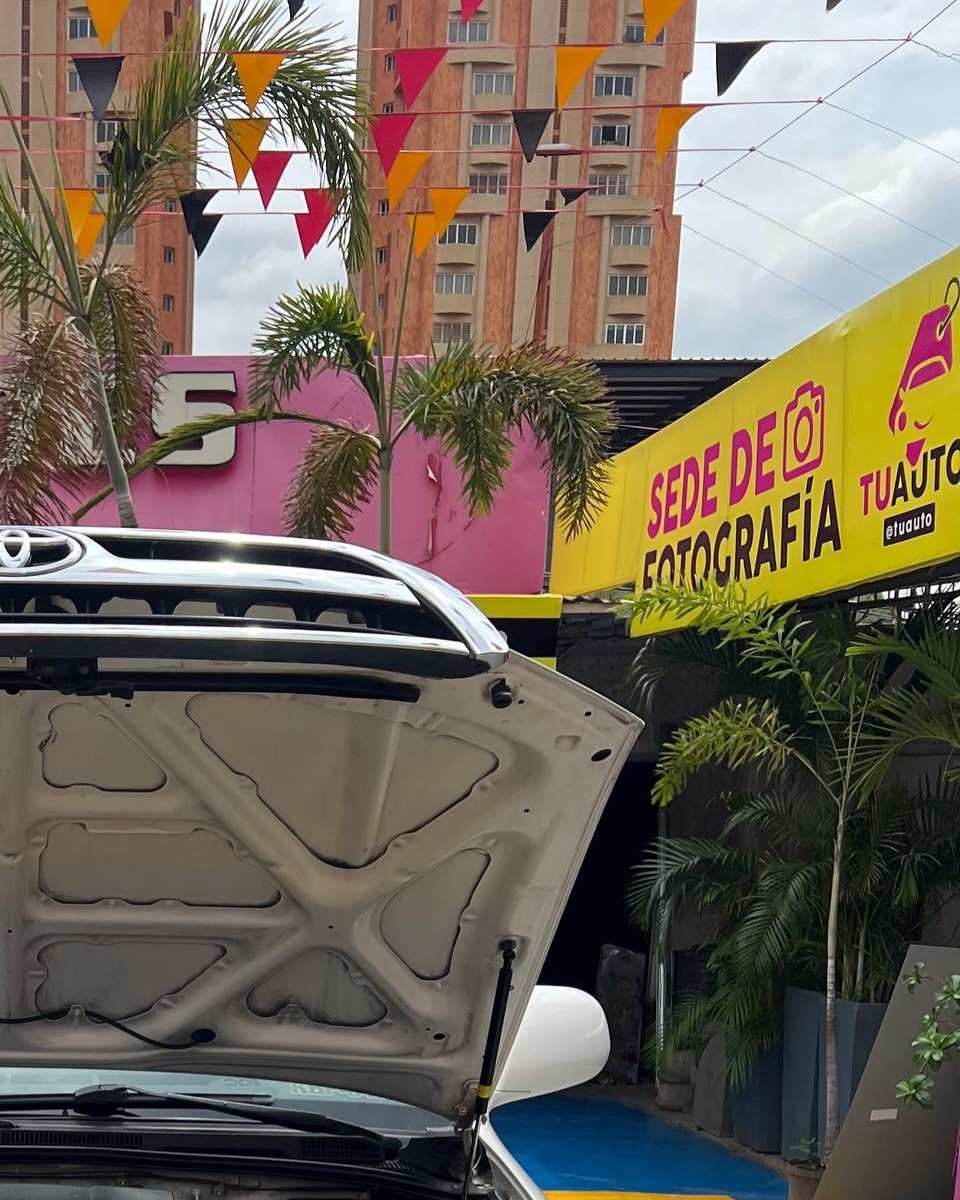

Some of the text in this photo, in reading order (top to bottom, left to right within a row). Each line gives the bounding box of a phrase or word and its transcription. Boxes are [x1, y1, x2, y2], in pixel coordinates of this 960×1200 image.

[642, 475, 842, 593] FOTOGRAFÍA
[647, 410, 777, 540] SEDE DE
[885, 512, 933, 540] @tuauto
